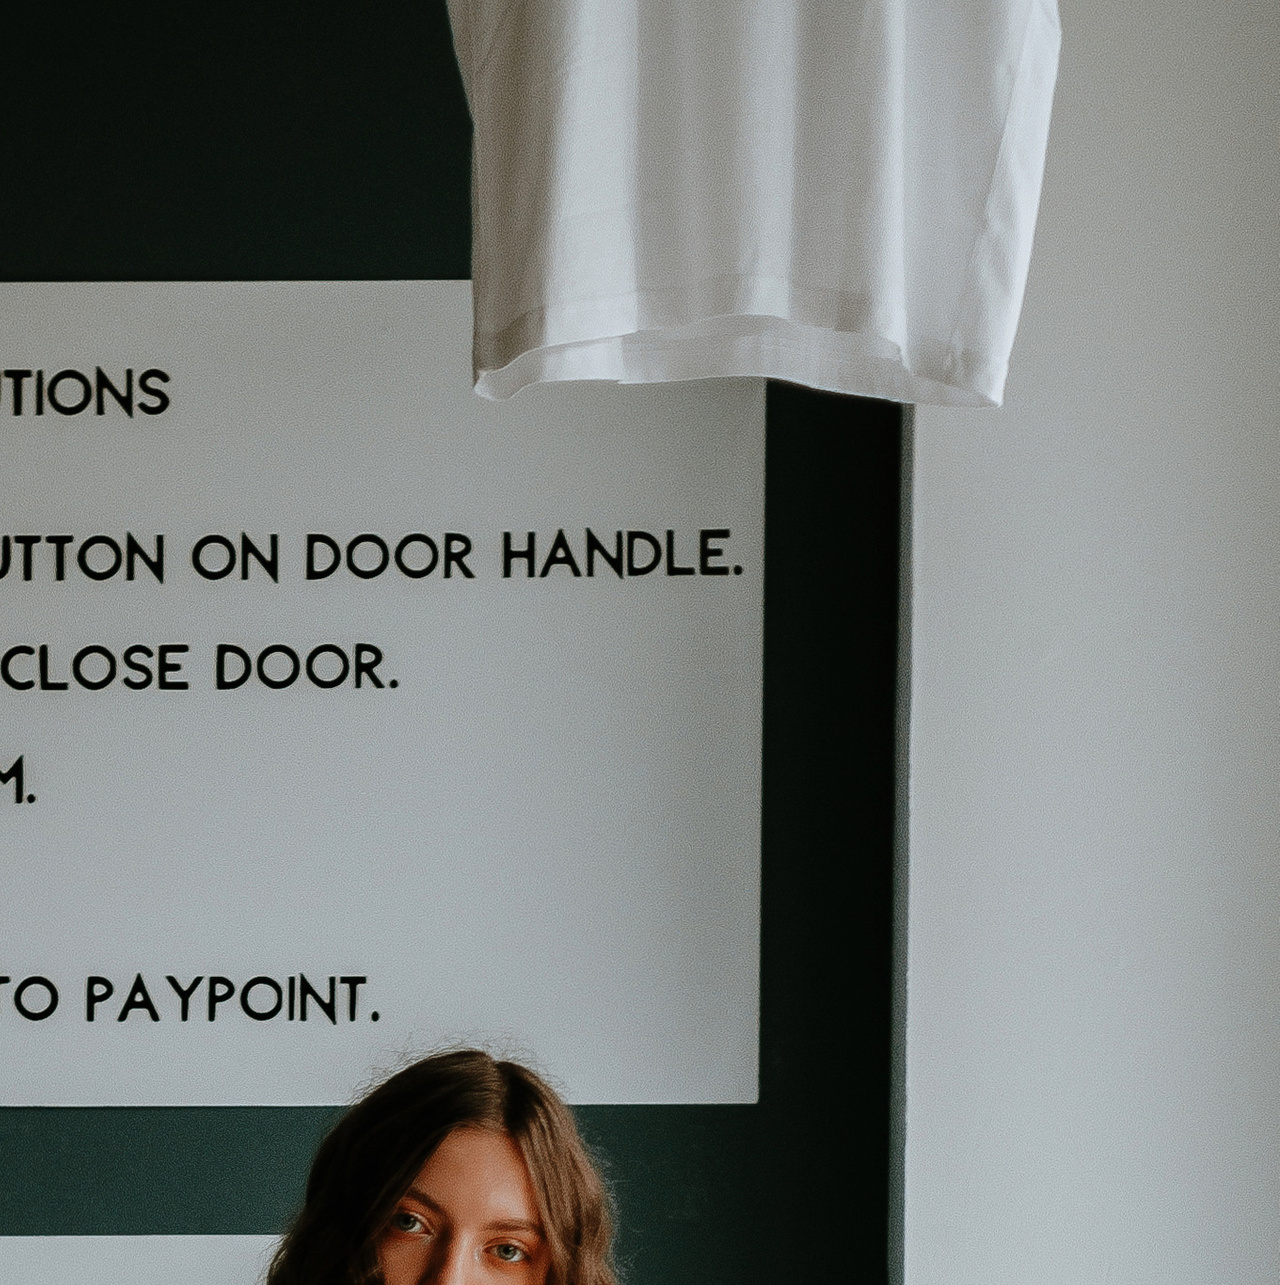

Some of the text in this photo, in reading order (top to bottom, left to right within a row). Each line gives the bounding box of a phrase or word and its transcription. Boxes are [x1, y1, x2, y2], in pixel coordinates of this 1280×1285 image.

[192, 532, 280, 585] ON
[306, 532, 476, 583] DOOR
[503, 527, 744, 581] HANDLE.
[0, 644, 191, 692] CLOSE
[216, 643, 400, 692] DOOR.
[86, 974, 381, 1027] PAYPOINT.
